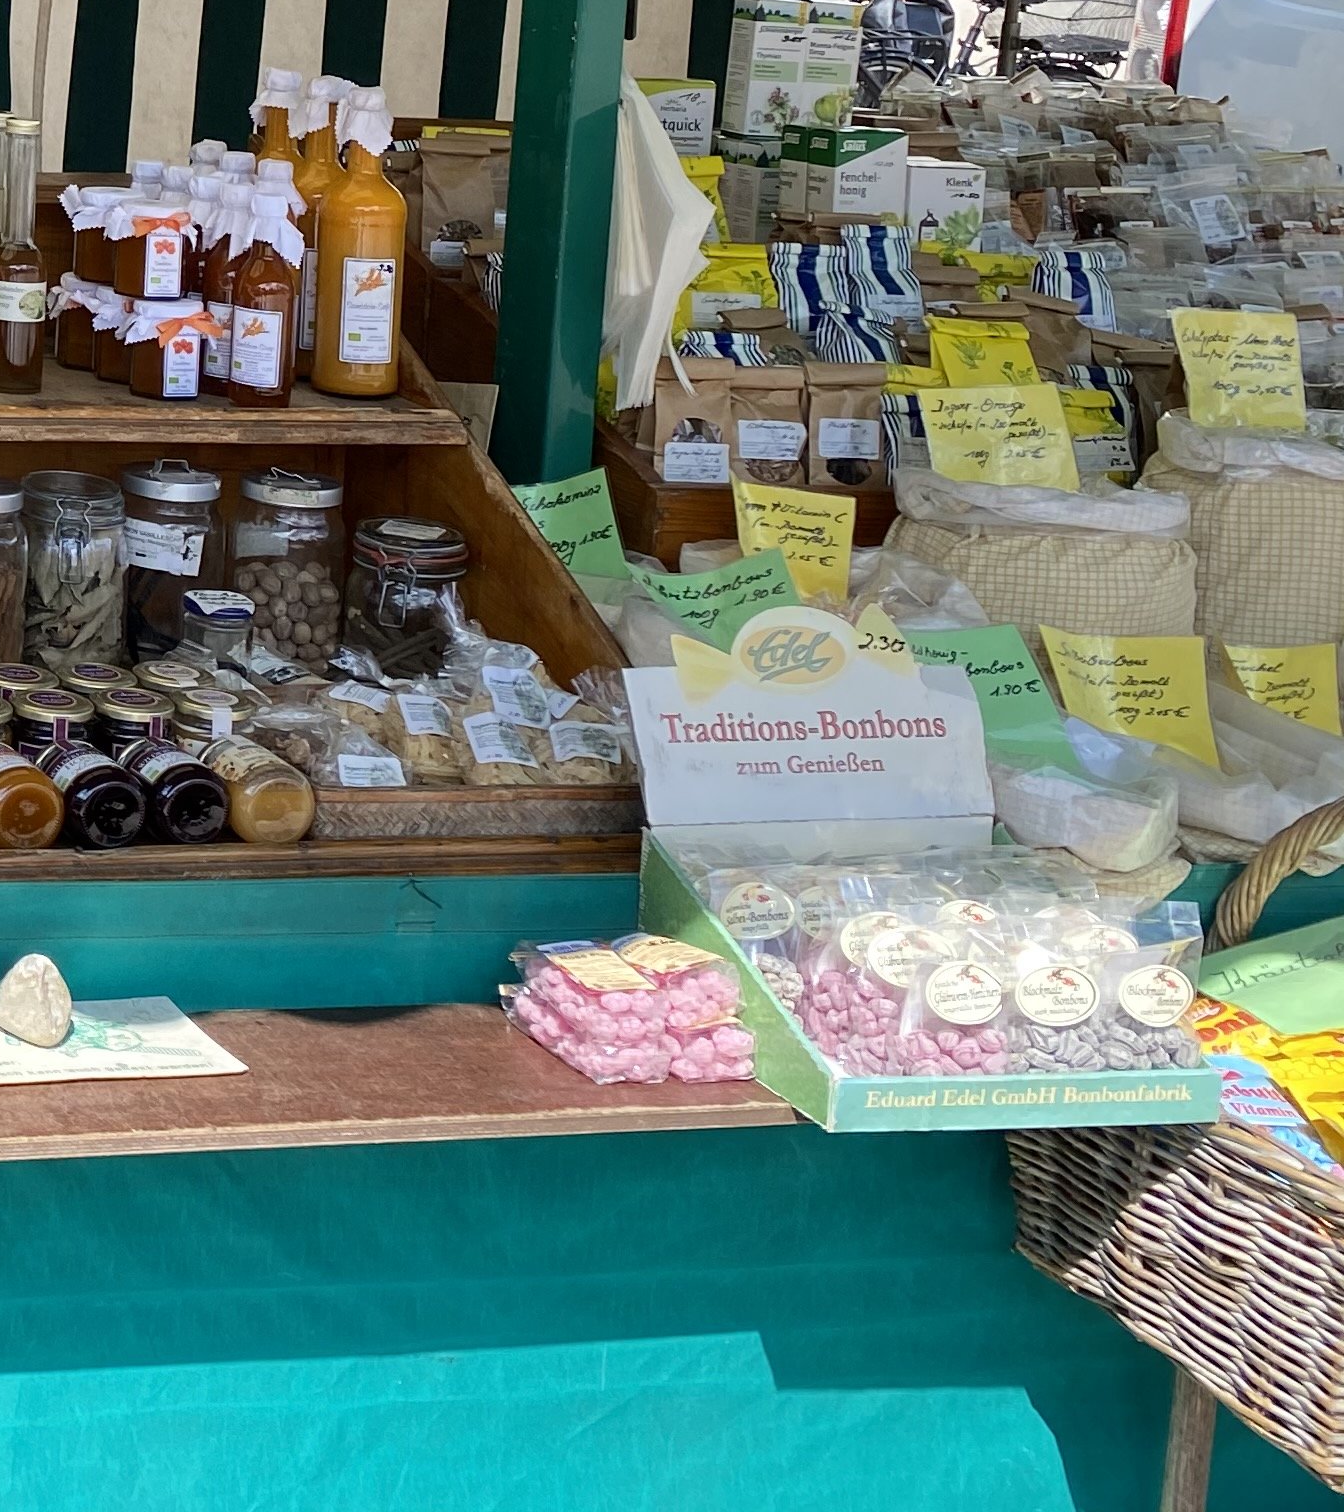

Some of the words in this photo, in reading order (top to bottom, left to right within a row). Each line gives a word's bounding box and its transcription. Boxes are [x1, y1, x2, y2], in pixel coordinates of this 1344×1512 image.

[839, 171, 882, 184] Fenchel-
[946, 176, 974, 188] Klenk
[839, 185, 867, 199] honig
[747, 624, 833, 683] Edel
[660, 709, 948, 745] Traditions-Bonbons
[736, 758, 783, 776] zum
[786, 751, 886, 776] Genießen
[864, 1091, 938, 1109] Eduard
[942, 1090, 986, 1108] Edel
[991, 1088, 1057, 1107] GmbH
[1062, 1083, 1193, 1105] Bonbonfabrik
[1230, 1102, 1299, 1118] Vitamin
